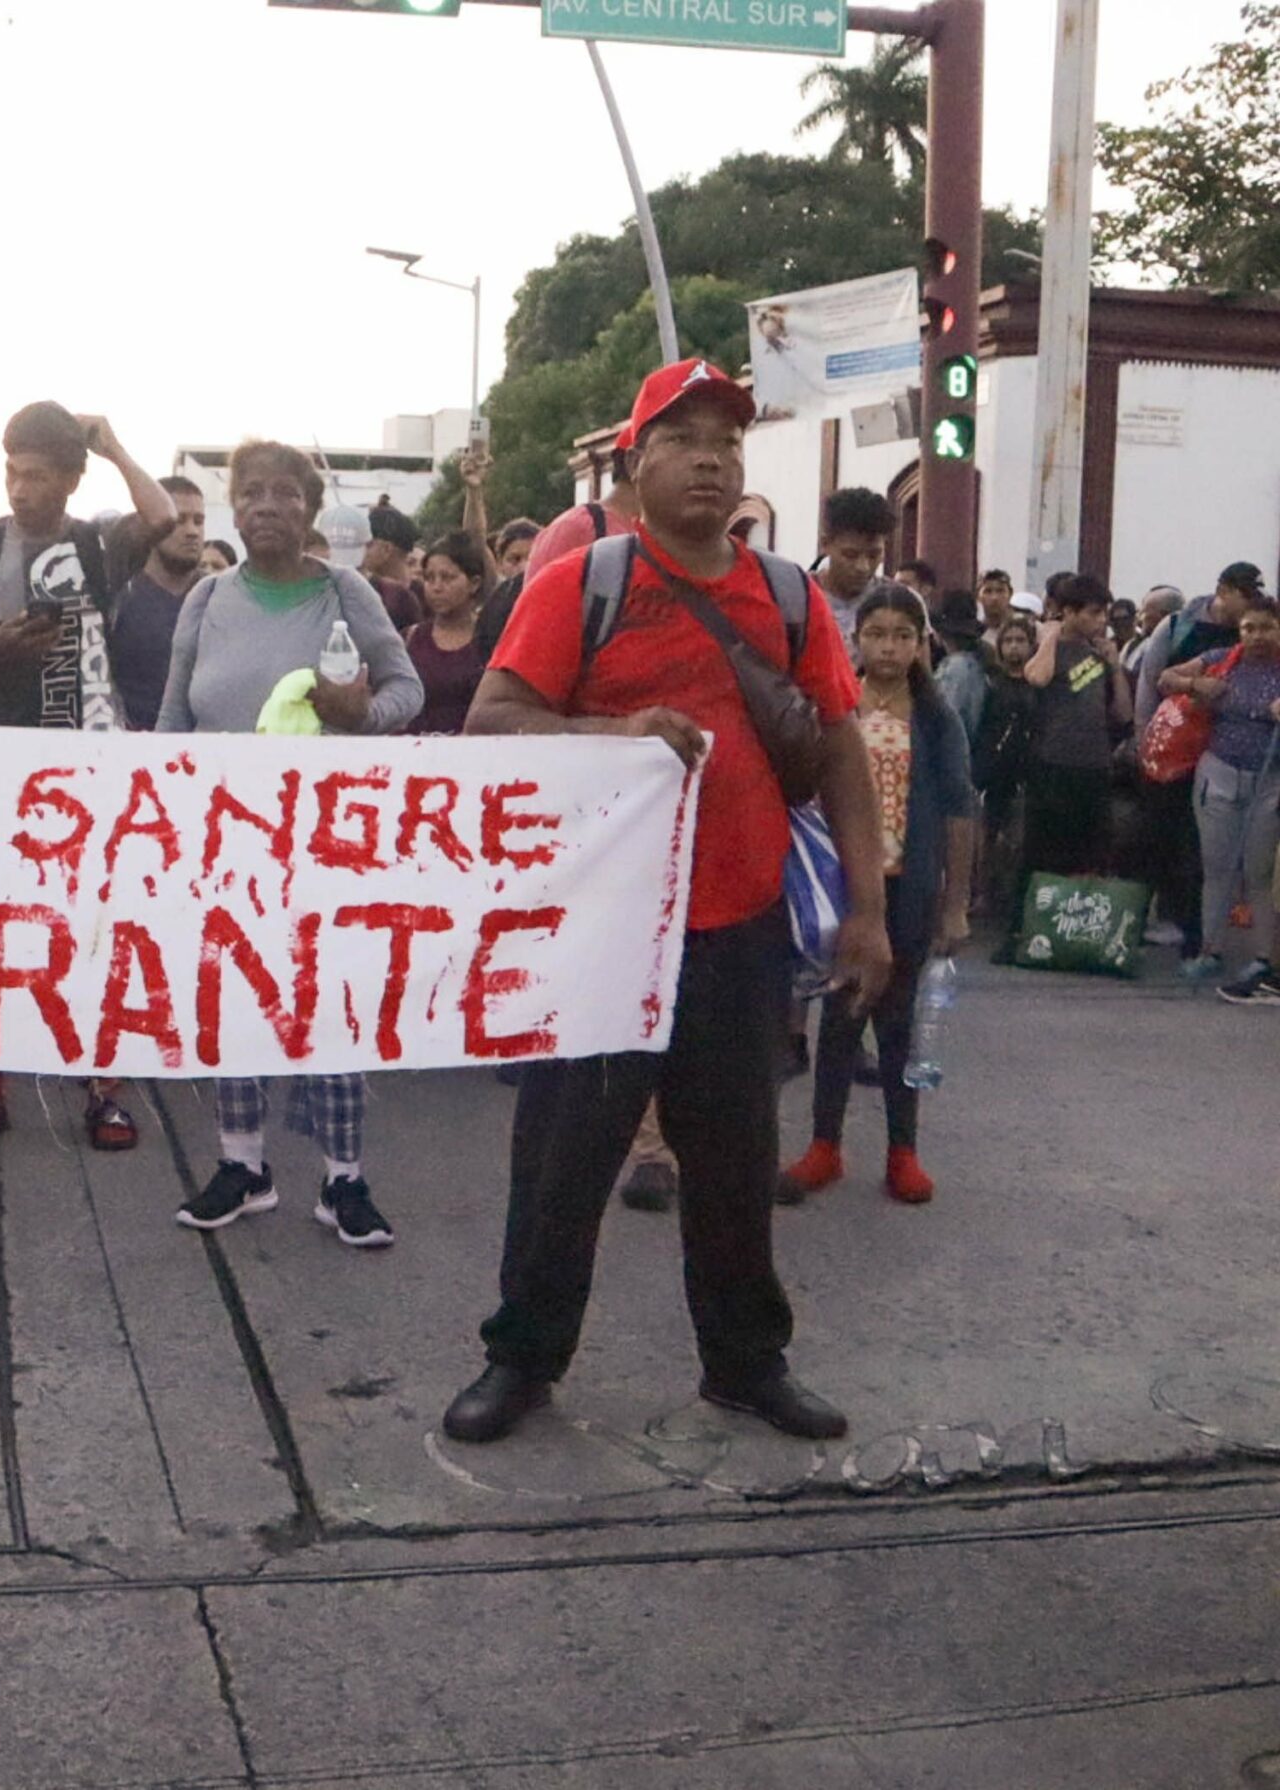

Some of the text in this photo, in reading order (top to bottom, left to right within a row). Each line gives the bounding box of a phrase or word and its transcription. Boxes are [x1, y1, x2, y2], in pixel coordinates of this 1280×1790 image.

[602, 0, 737, 24] CENTRAL
[747, 2, 808, 27] SUR
[8, 764, 562, 880] SANGRE
